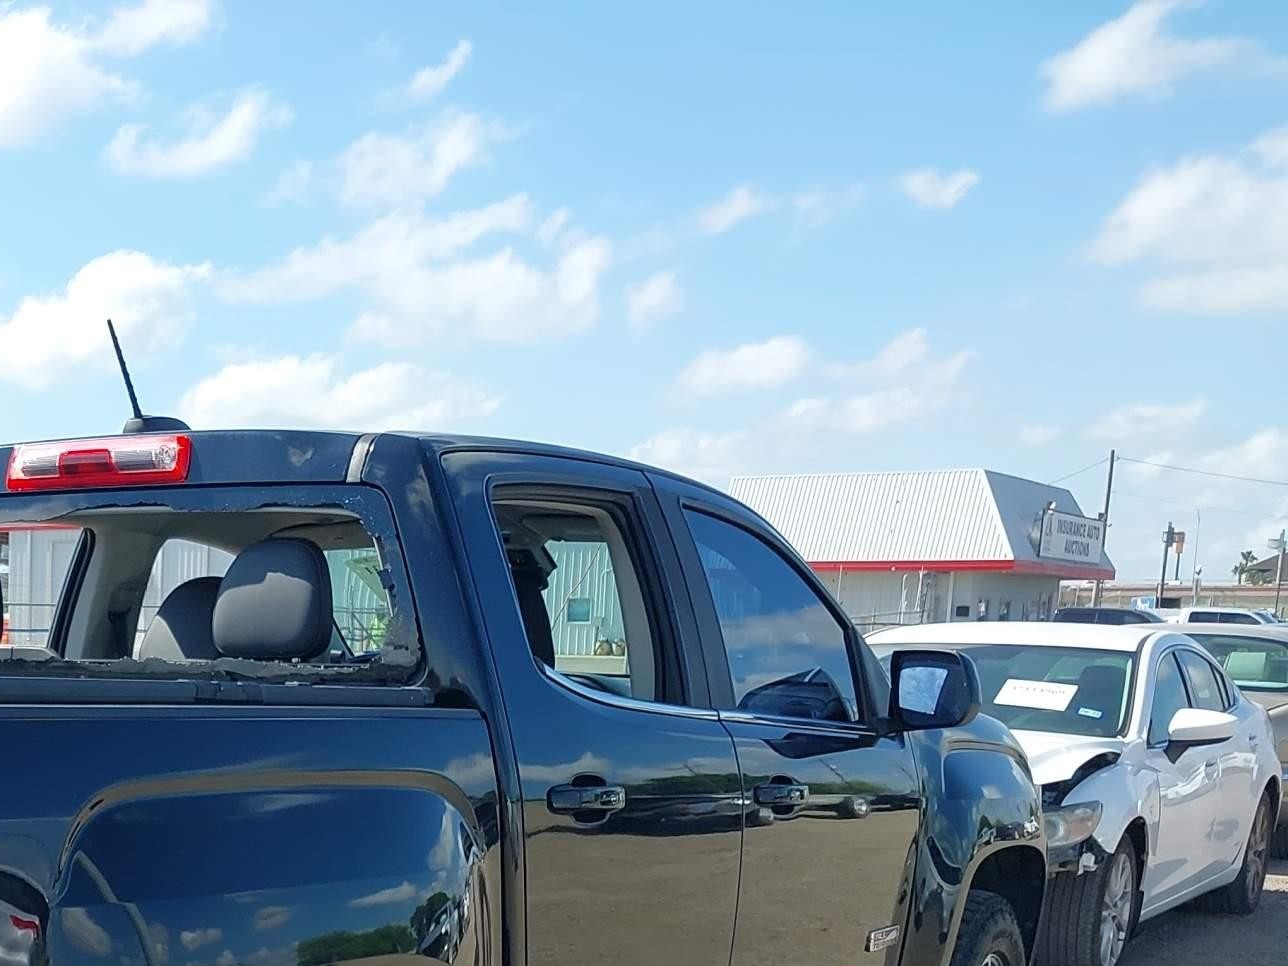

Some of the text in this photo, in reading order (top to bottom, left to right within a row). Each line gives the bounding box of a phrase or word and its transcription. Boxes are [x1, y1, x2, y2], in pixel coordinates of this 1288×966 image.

[1057, 519, 1087, 537] INSURANCE
[1087, 523, 1100, 540] AUTO
[1064, 539, 1090, 557] AUCTIONS
